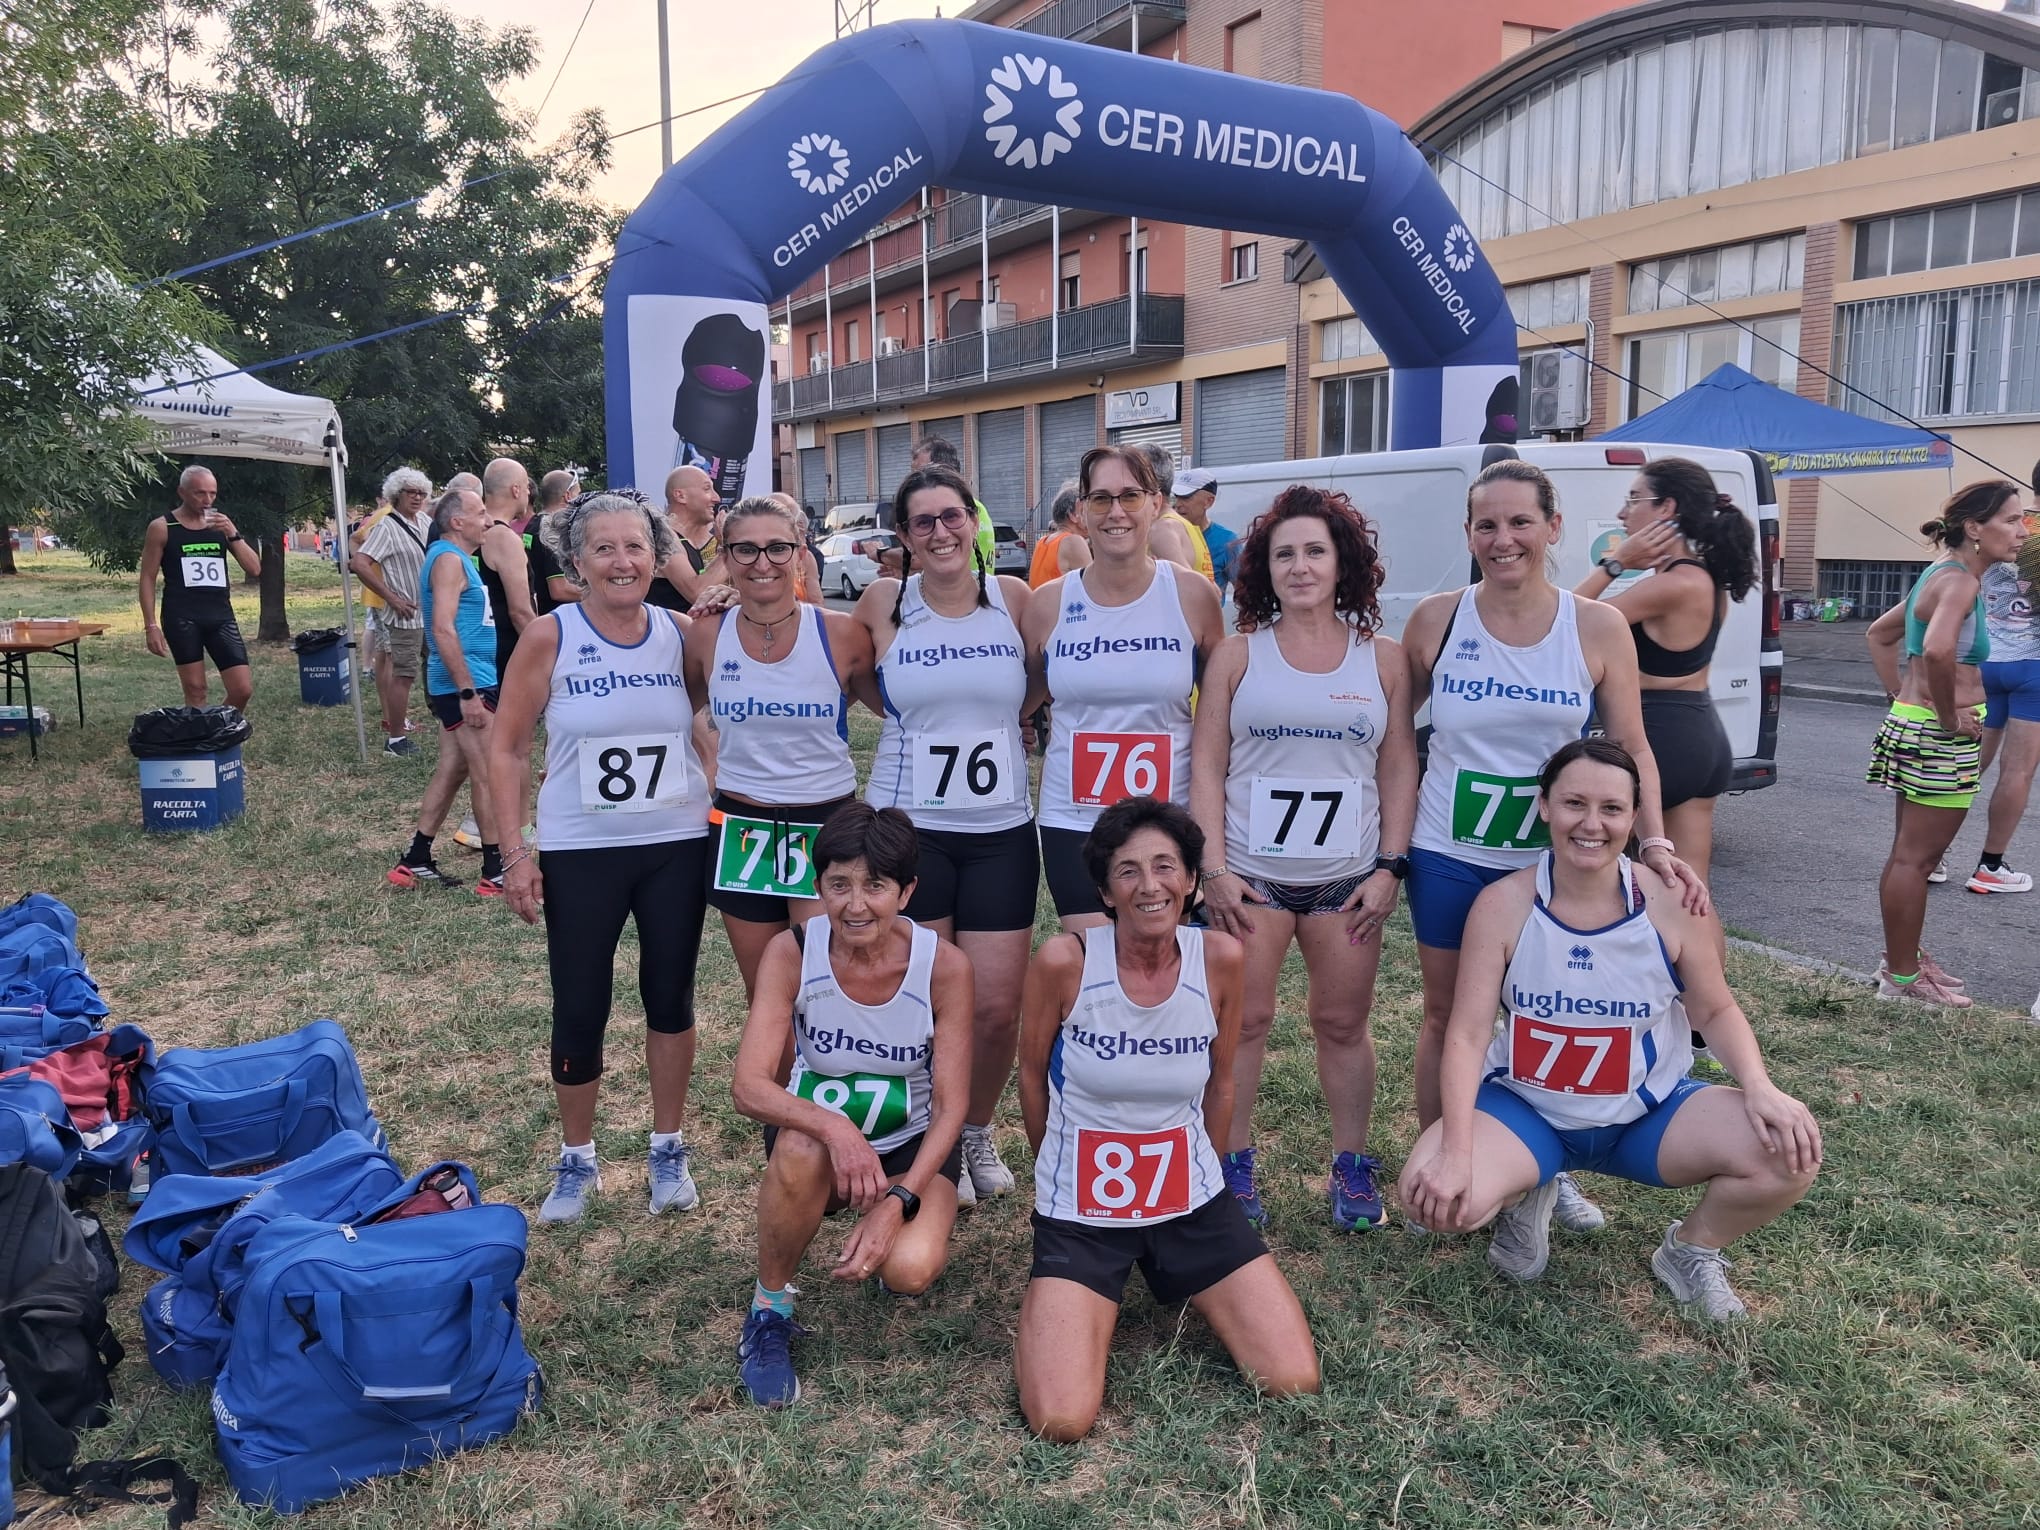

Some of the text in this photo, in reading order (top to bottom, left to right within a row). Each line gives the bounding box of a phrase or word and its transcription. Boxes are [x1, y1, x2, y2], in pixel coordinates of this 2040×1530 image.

[1098, 104, 1366, 183] CER MEDICAL
[773, 147, 923, 267] CER MEDICAL
[1392, 216, 1478, 336] CER MEDICAL
[1809, 452, 1849, 470] ATLETICA
[190, 561, 219, 581] 36
[898, 644, 1020, 667] lughesina
[1055, 636, 1182, 661] lughesina
[565, 670, 683, 698] lughesina
[1442, 673, 1582, 707] lughesina
[713, 697, 834, 723] lughesina
[1249, 725, 1343, 741] lughesina
[222, 770, 237, 781] CARTA
[598, 745, 668, 802] 87
[929, 741, 998, 798] 76
[1086, 742, 1158, 797] 76
[153, 800, 207, 809] RACCOLTA
[163, 810, 198, 819] CARTA
[1270, 790, 1343, 847] 77
[1470, 781, 1540, 840] 77
[738, 828, 808, 886] 76
[1512, 984, 1650, 1018] lughesina
[799, 1013, 929, 1063] lughesina
[1071, 1024, 1209, 1061] lughesina
[1530, 1028, 1613, 1087] 77
[812, 1079, 890, 1135] 87
[1091, 1140, 1174, 1209] 87
[1093, 1209, 1113, 1217] UISP
